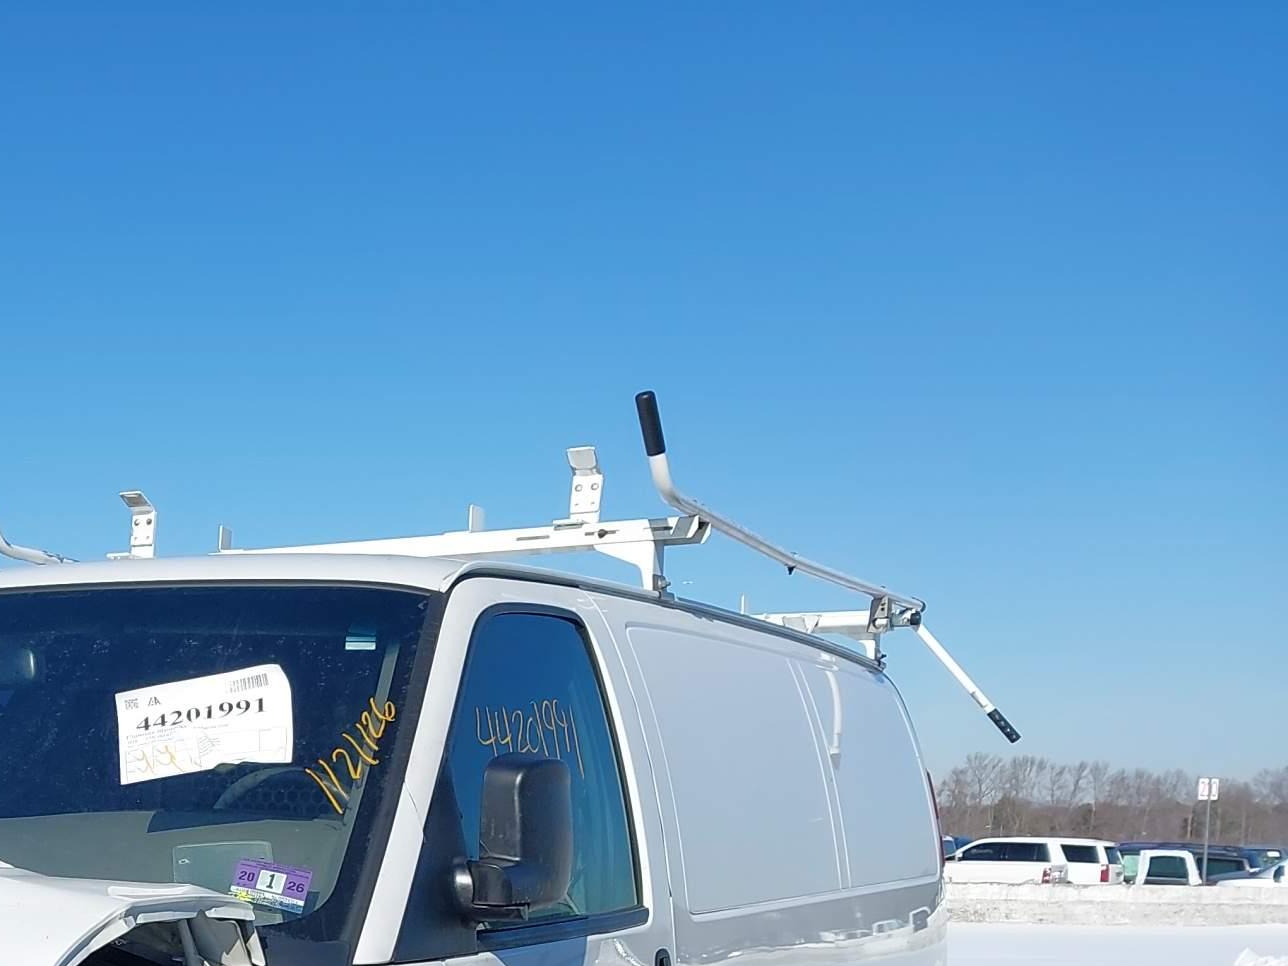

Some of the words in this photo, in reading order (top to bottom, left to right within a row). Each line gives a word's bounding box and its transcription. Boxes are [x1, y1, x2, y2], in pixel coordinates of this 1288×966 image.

[135, 697, 268, 732] 44201991
[475, 698, 585, 781] 44201991
[238, 870, 256, 882] 20
[265, 873, 276, 889] 1
[286, 881, 305, 893] 26
